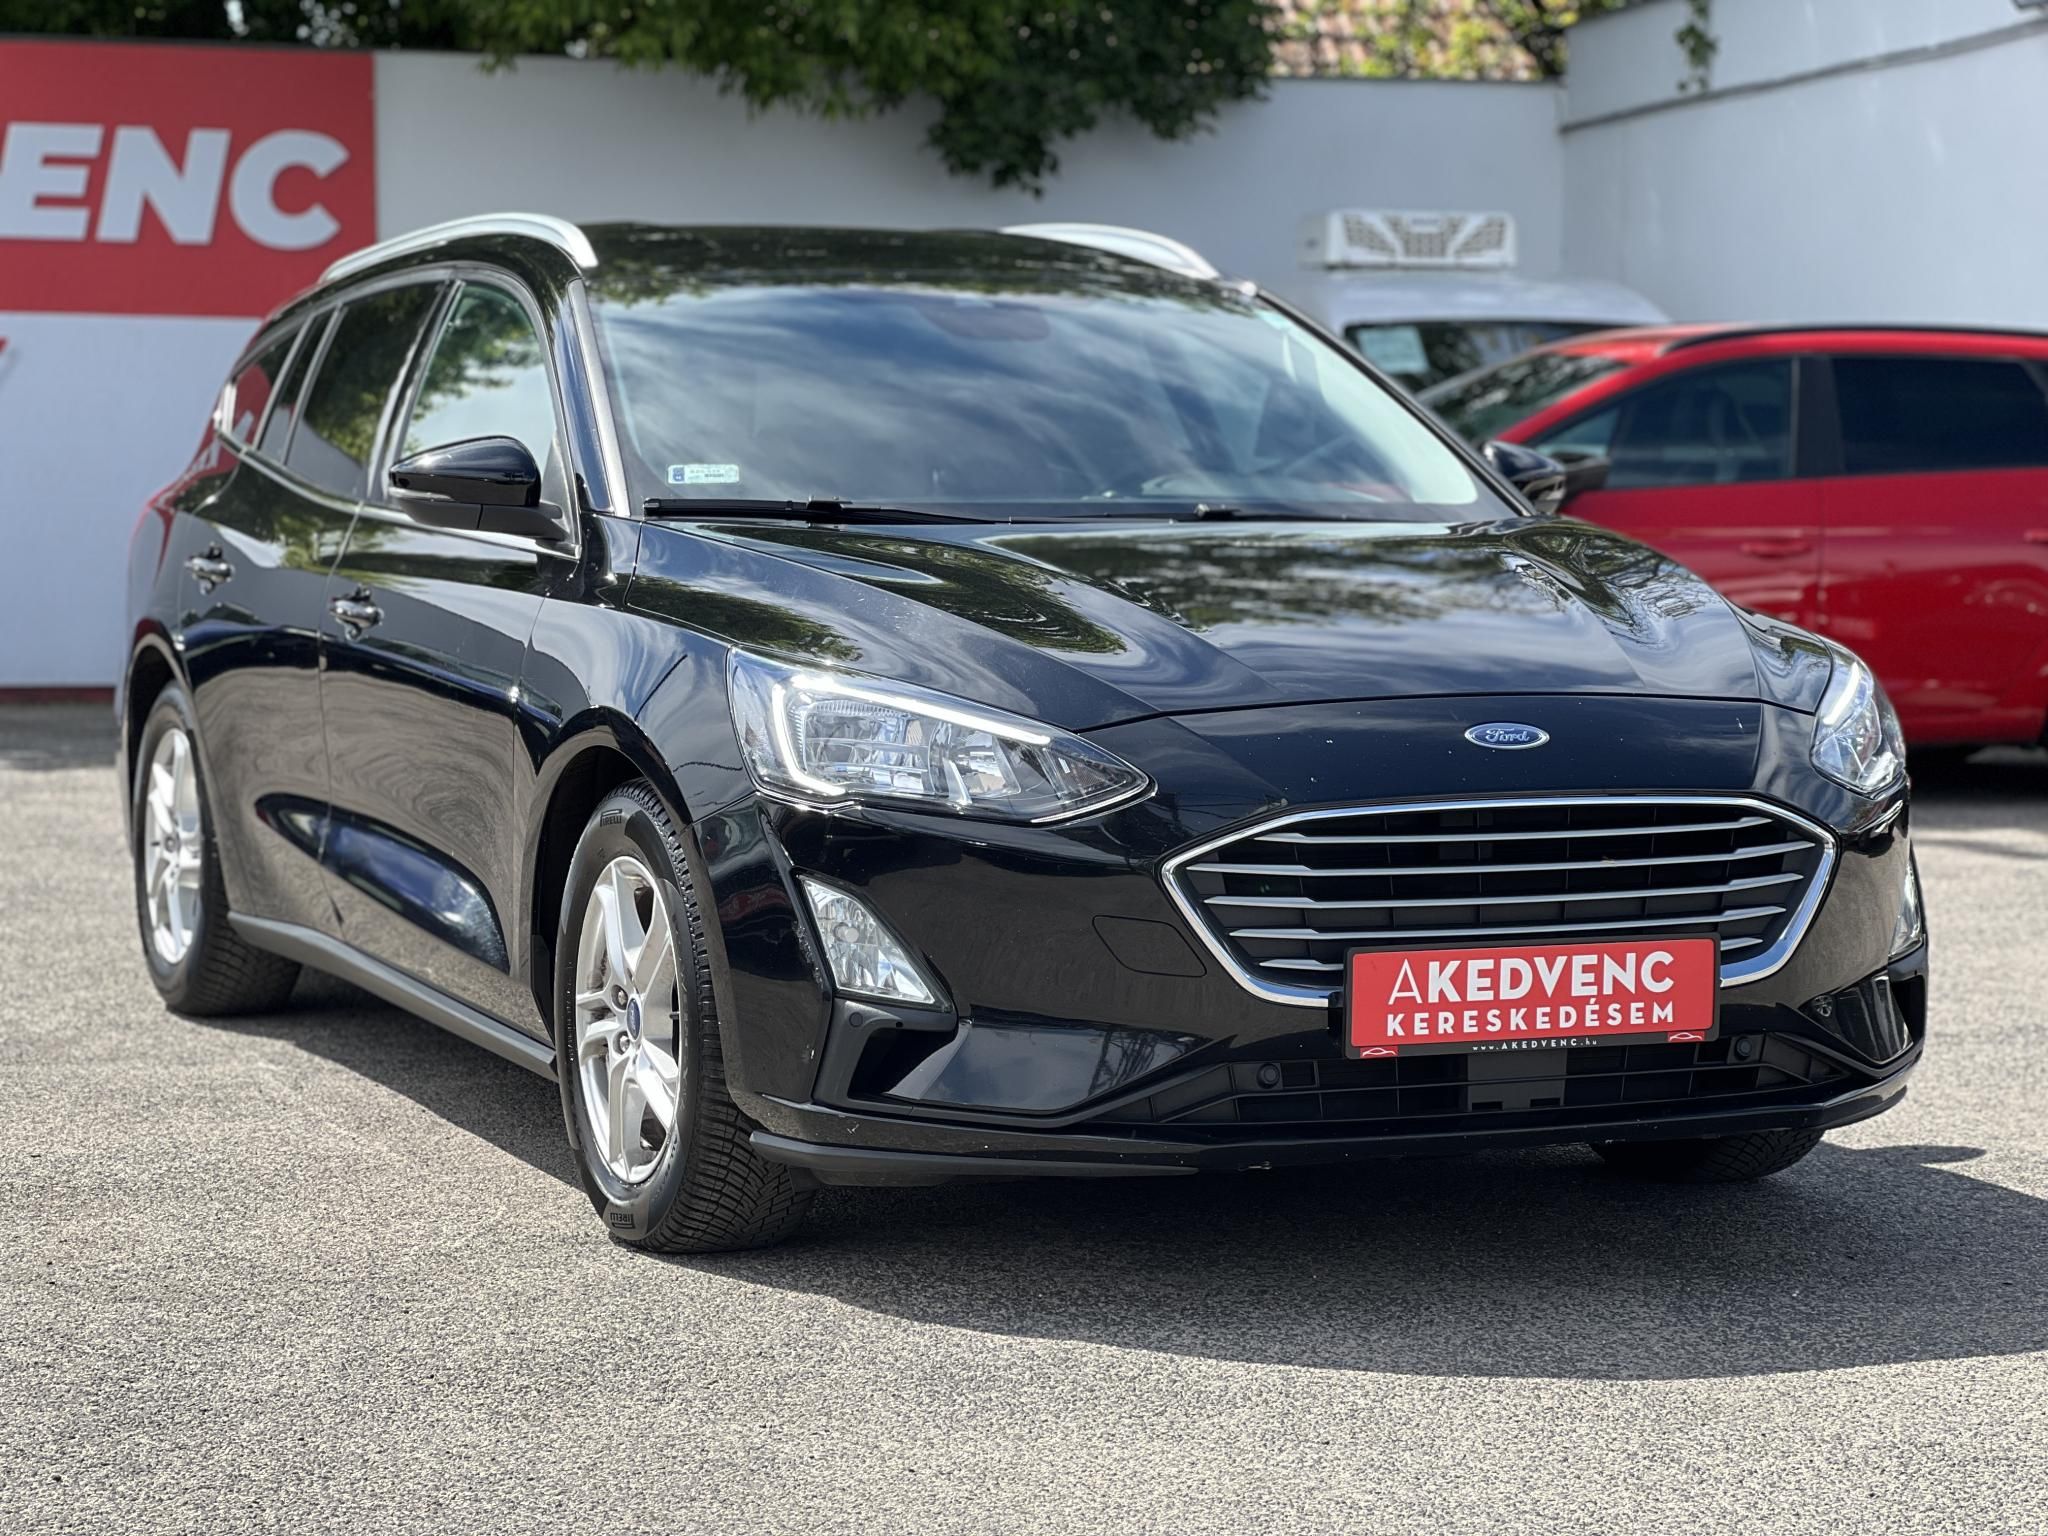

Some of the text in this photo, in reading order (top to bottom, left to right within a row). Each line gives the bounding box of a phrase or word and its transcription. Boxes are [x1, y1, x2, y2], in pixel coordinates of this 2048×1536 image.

[0, 122, 350, 251] ENC
[1485, 728, 1530, 742] Ford
[1386, 999, 1674, 1037] KERESKEDÉSEM
[1472, 1037, 1597, 1051] www.AKEDVENC.hu
